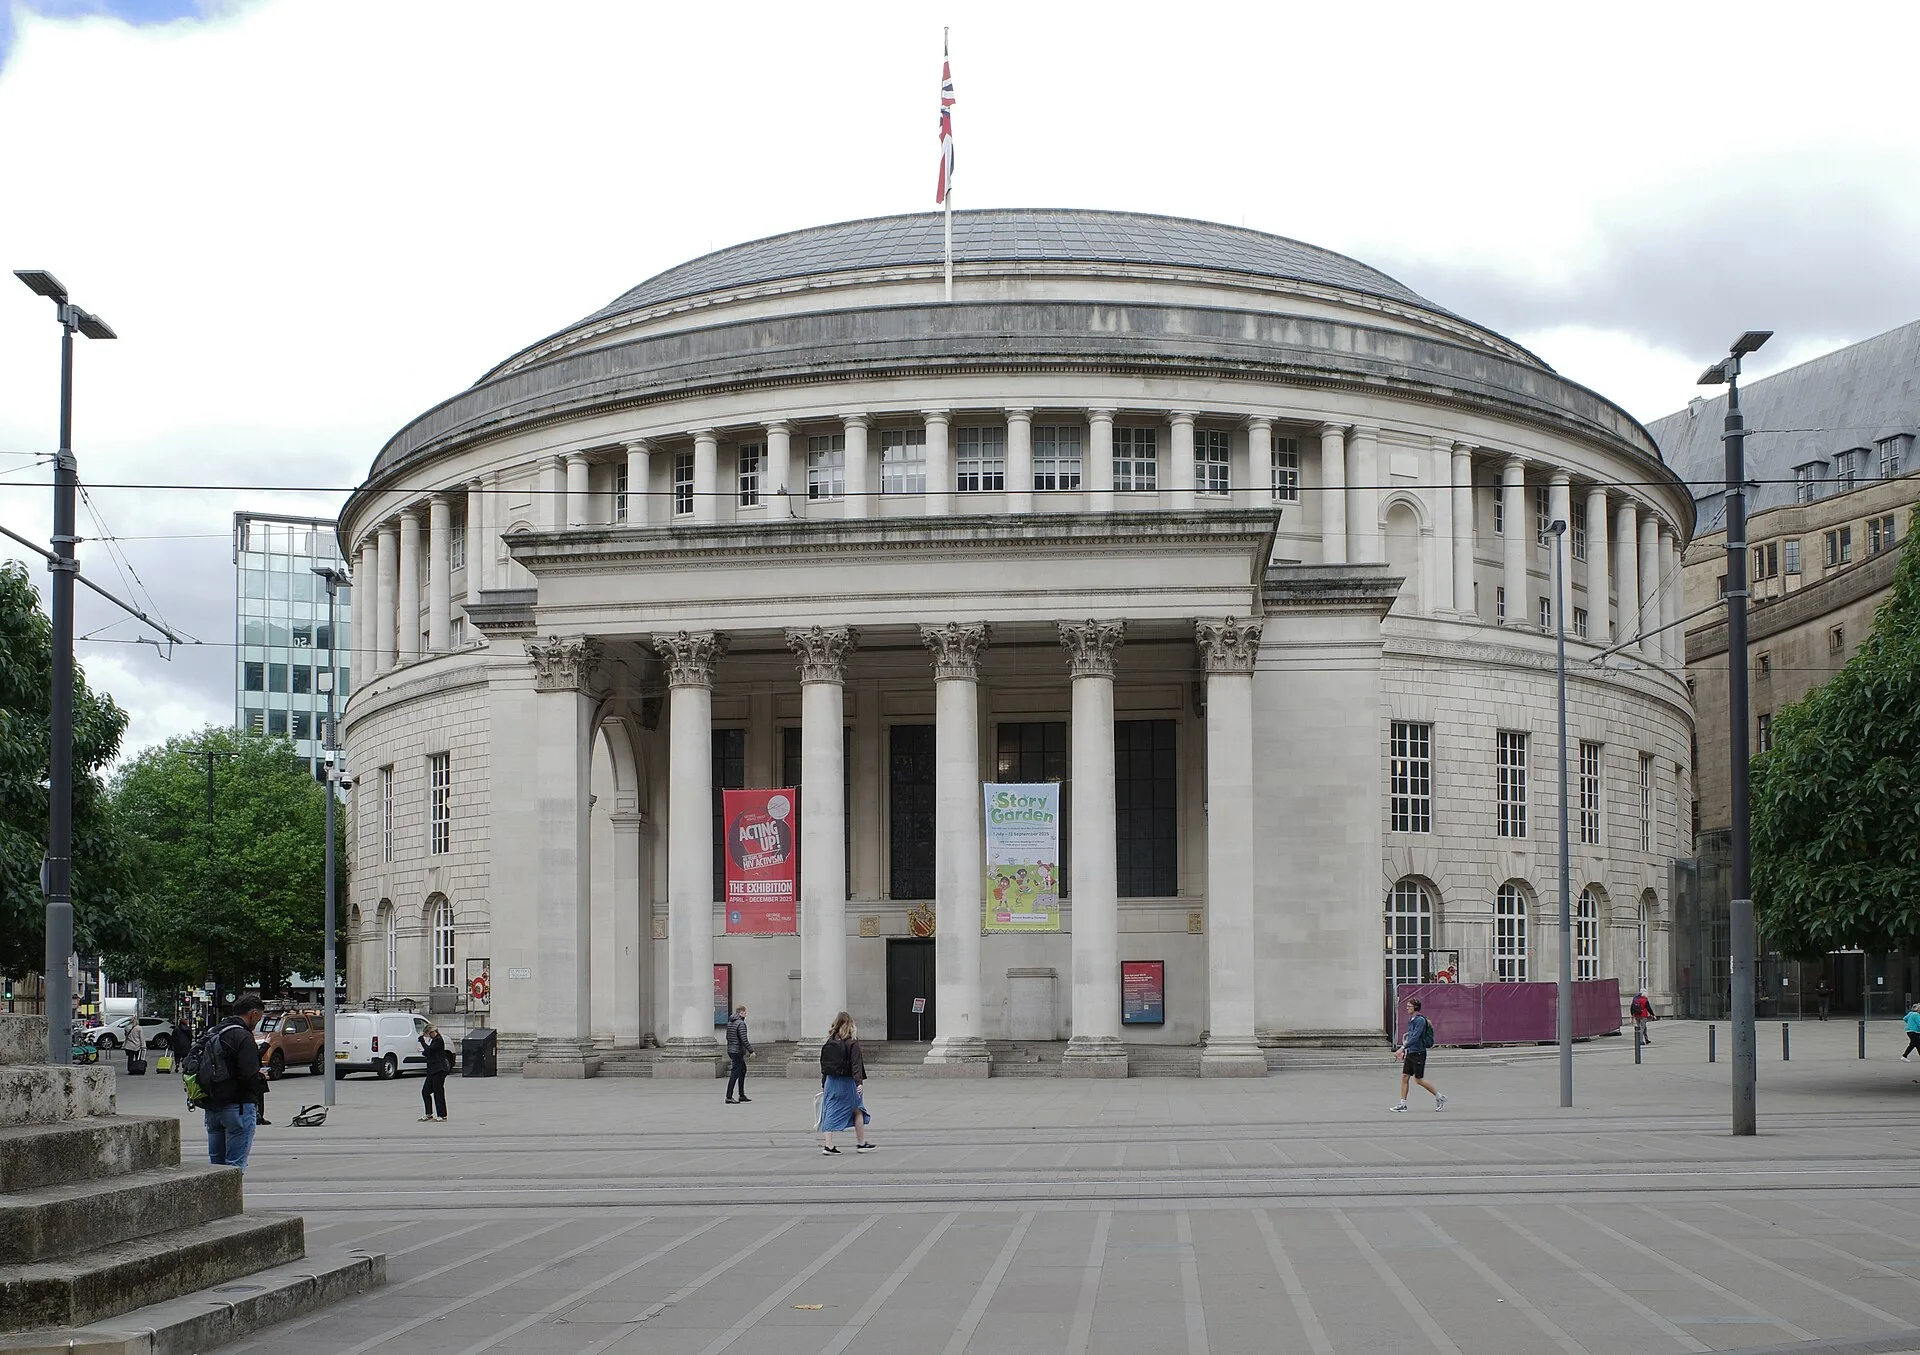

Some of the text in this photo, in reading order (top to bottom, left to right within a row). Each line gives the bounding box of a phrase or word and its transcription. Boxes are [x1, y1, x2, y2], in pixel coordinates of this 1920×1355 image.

[997, 792, 1047, 810] Story
[991, 808, 1054, 824] Garden
[739, 820, 778, 841] ACTING
[760, 834, 781, 851] UP!
[743, 854, 784, 869] HIV ACTIVISM
[729, 882, 792, 893] THE EXHIBITION
